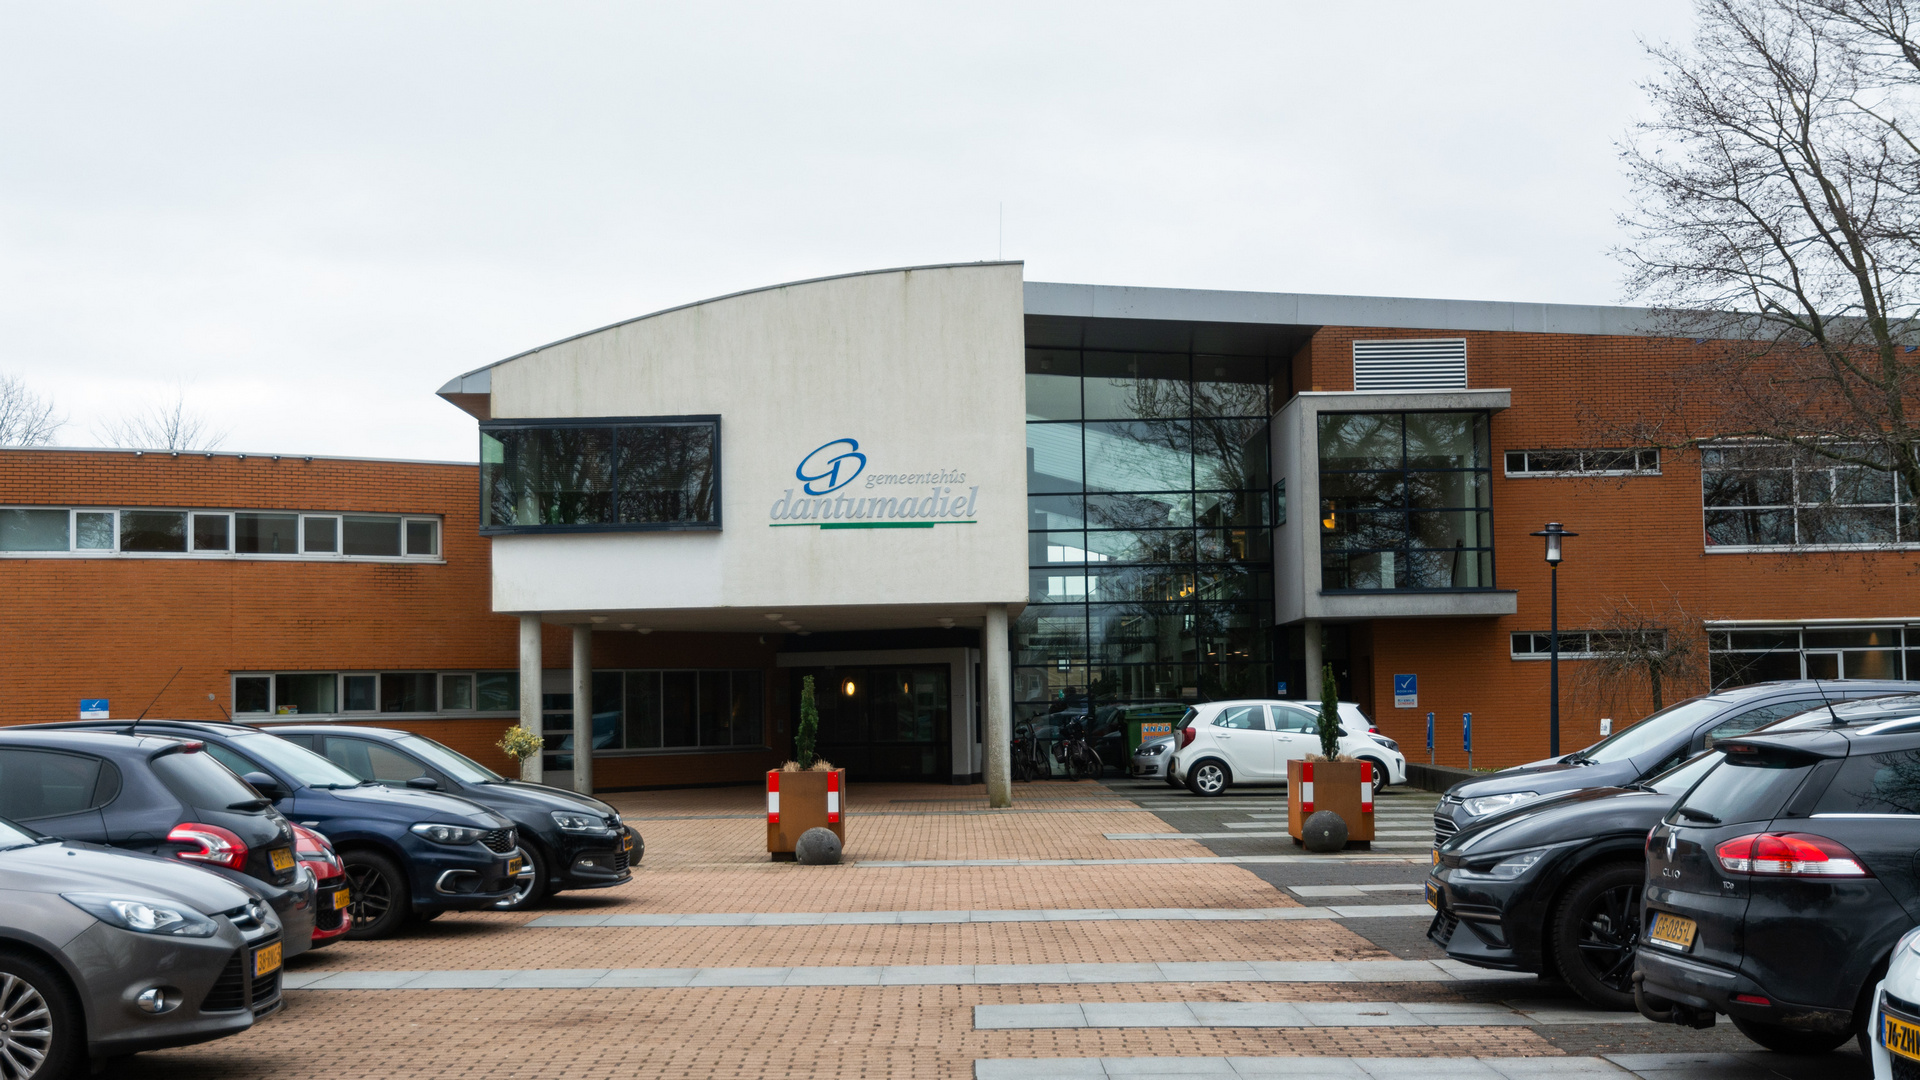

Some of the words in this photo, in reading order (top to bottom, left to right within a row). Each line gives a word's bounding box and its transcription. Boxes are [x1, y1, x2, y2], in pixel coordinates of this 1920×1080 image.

[865, 469, 966, 488] gemeentehûs
[769, 486, 979, 520] dantumadiel
[1143, 725, 1170, 733] NNRD
[1663, 867, 1681, 879] CLIO
[1655, 916, 1692, 942] GF-085-L
